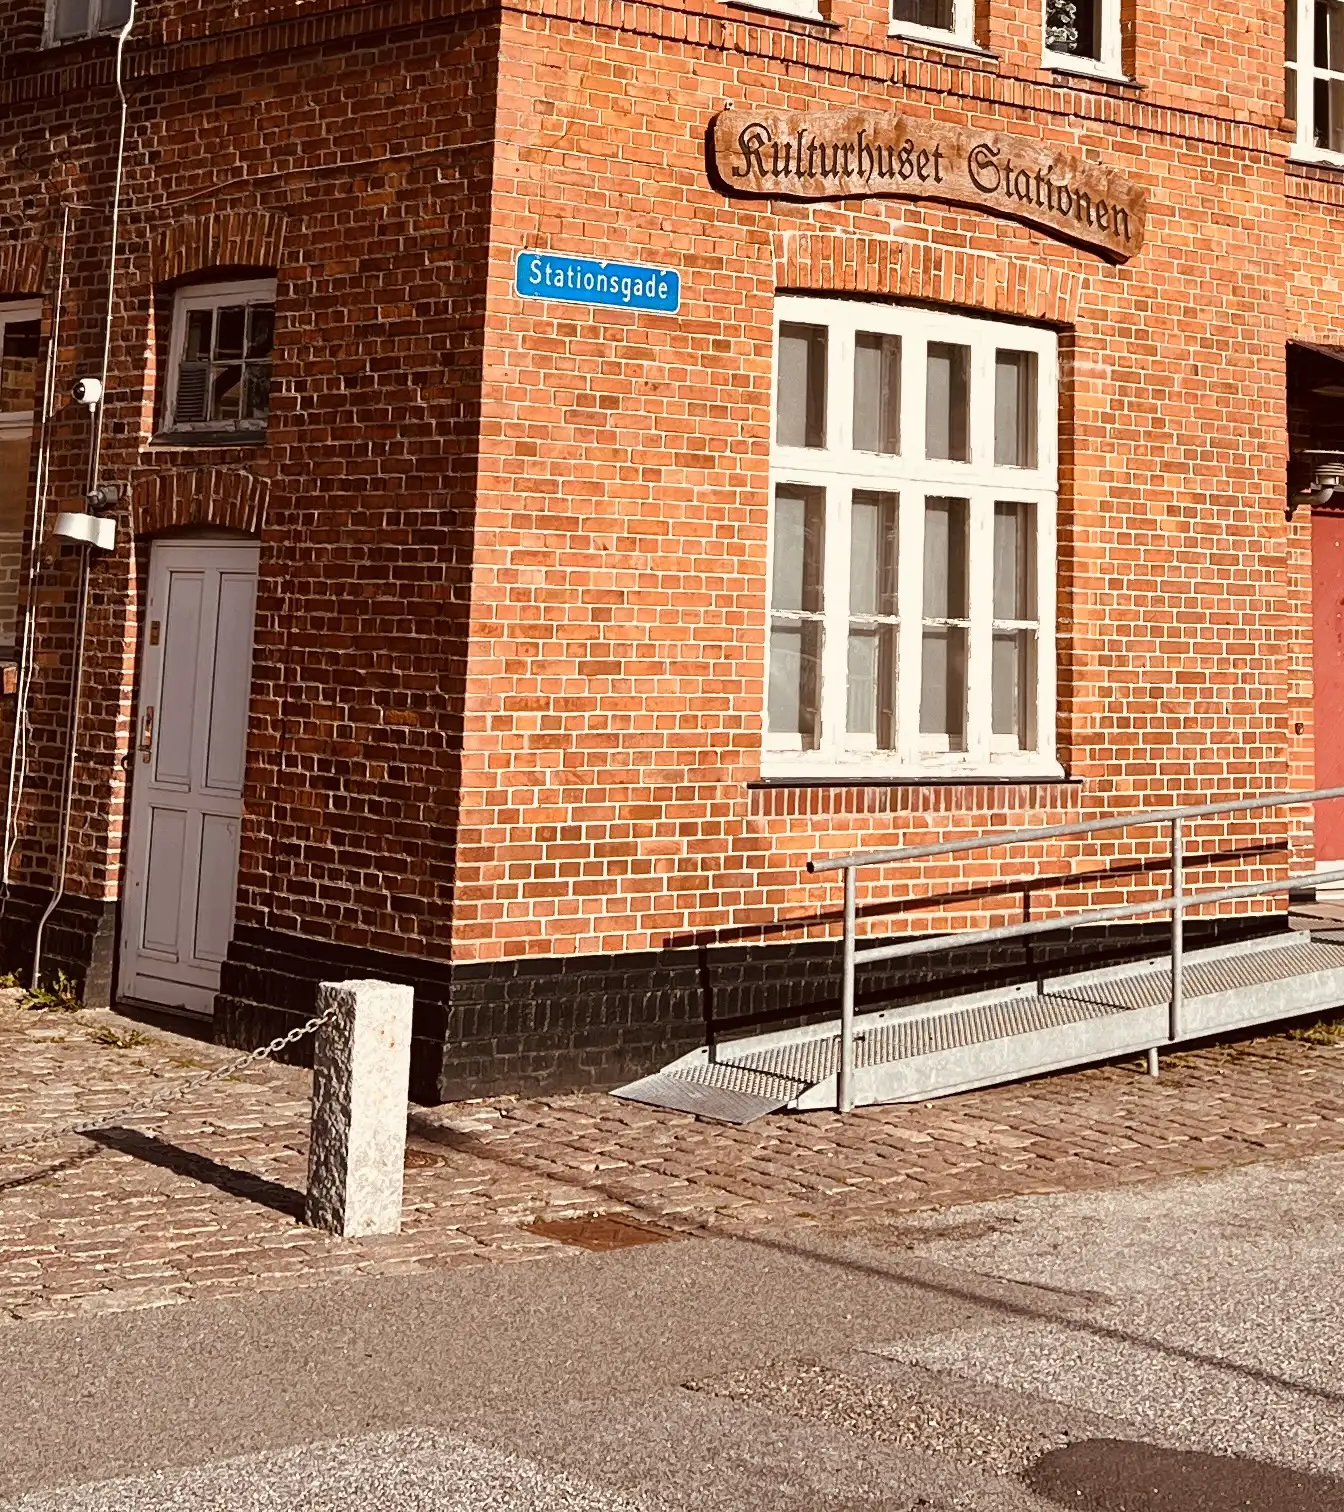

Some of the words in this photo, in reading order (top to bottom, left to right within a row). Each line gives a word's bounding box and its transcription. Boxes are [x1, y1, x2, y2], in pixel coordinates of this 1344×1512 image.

[731, 122, 944, 184] Kulturhuset
[967, 142, 1133, 243] Stationen
[529, 259, 669, 303] Stationsgade
